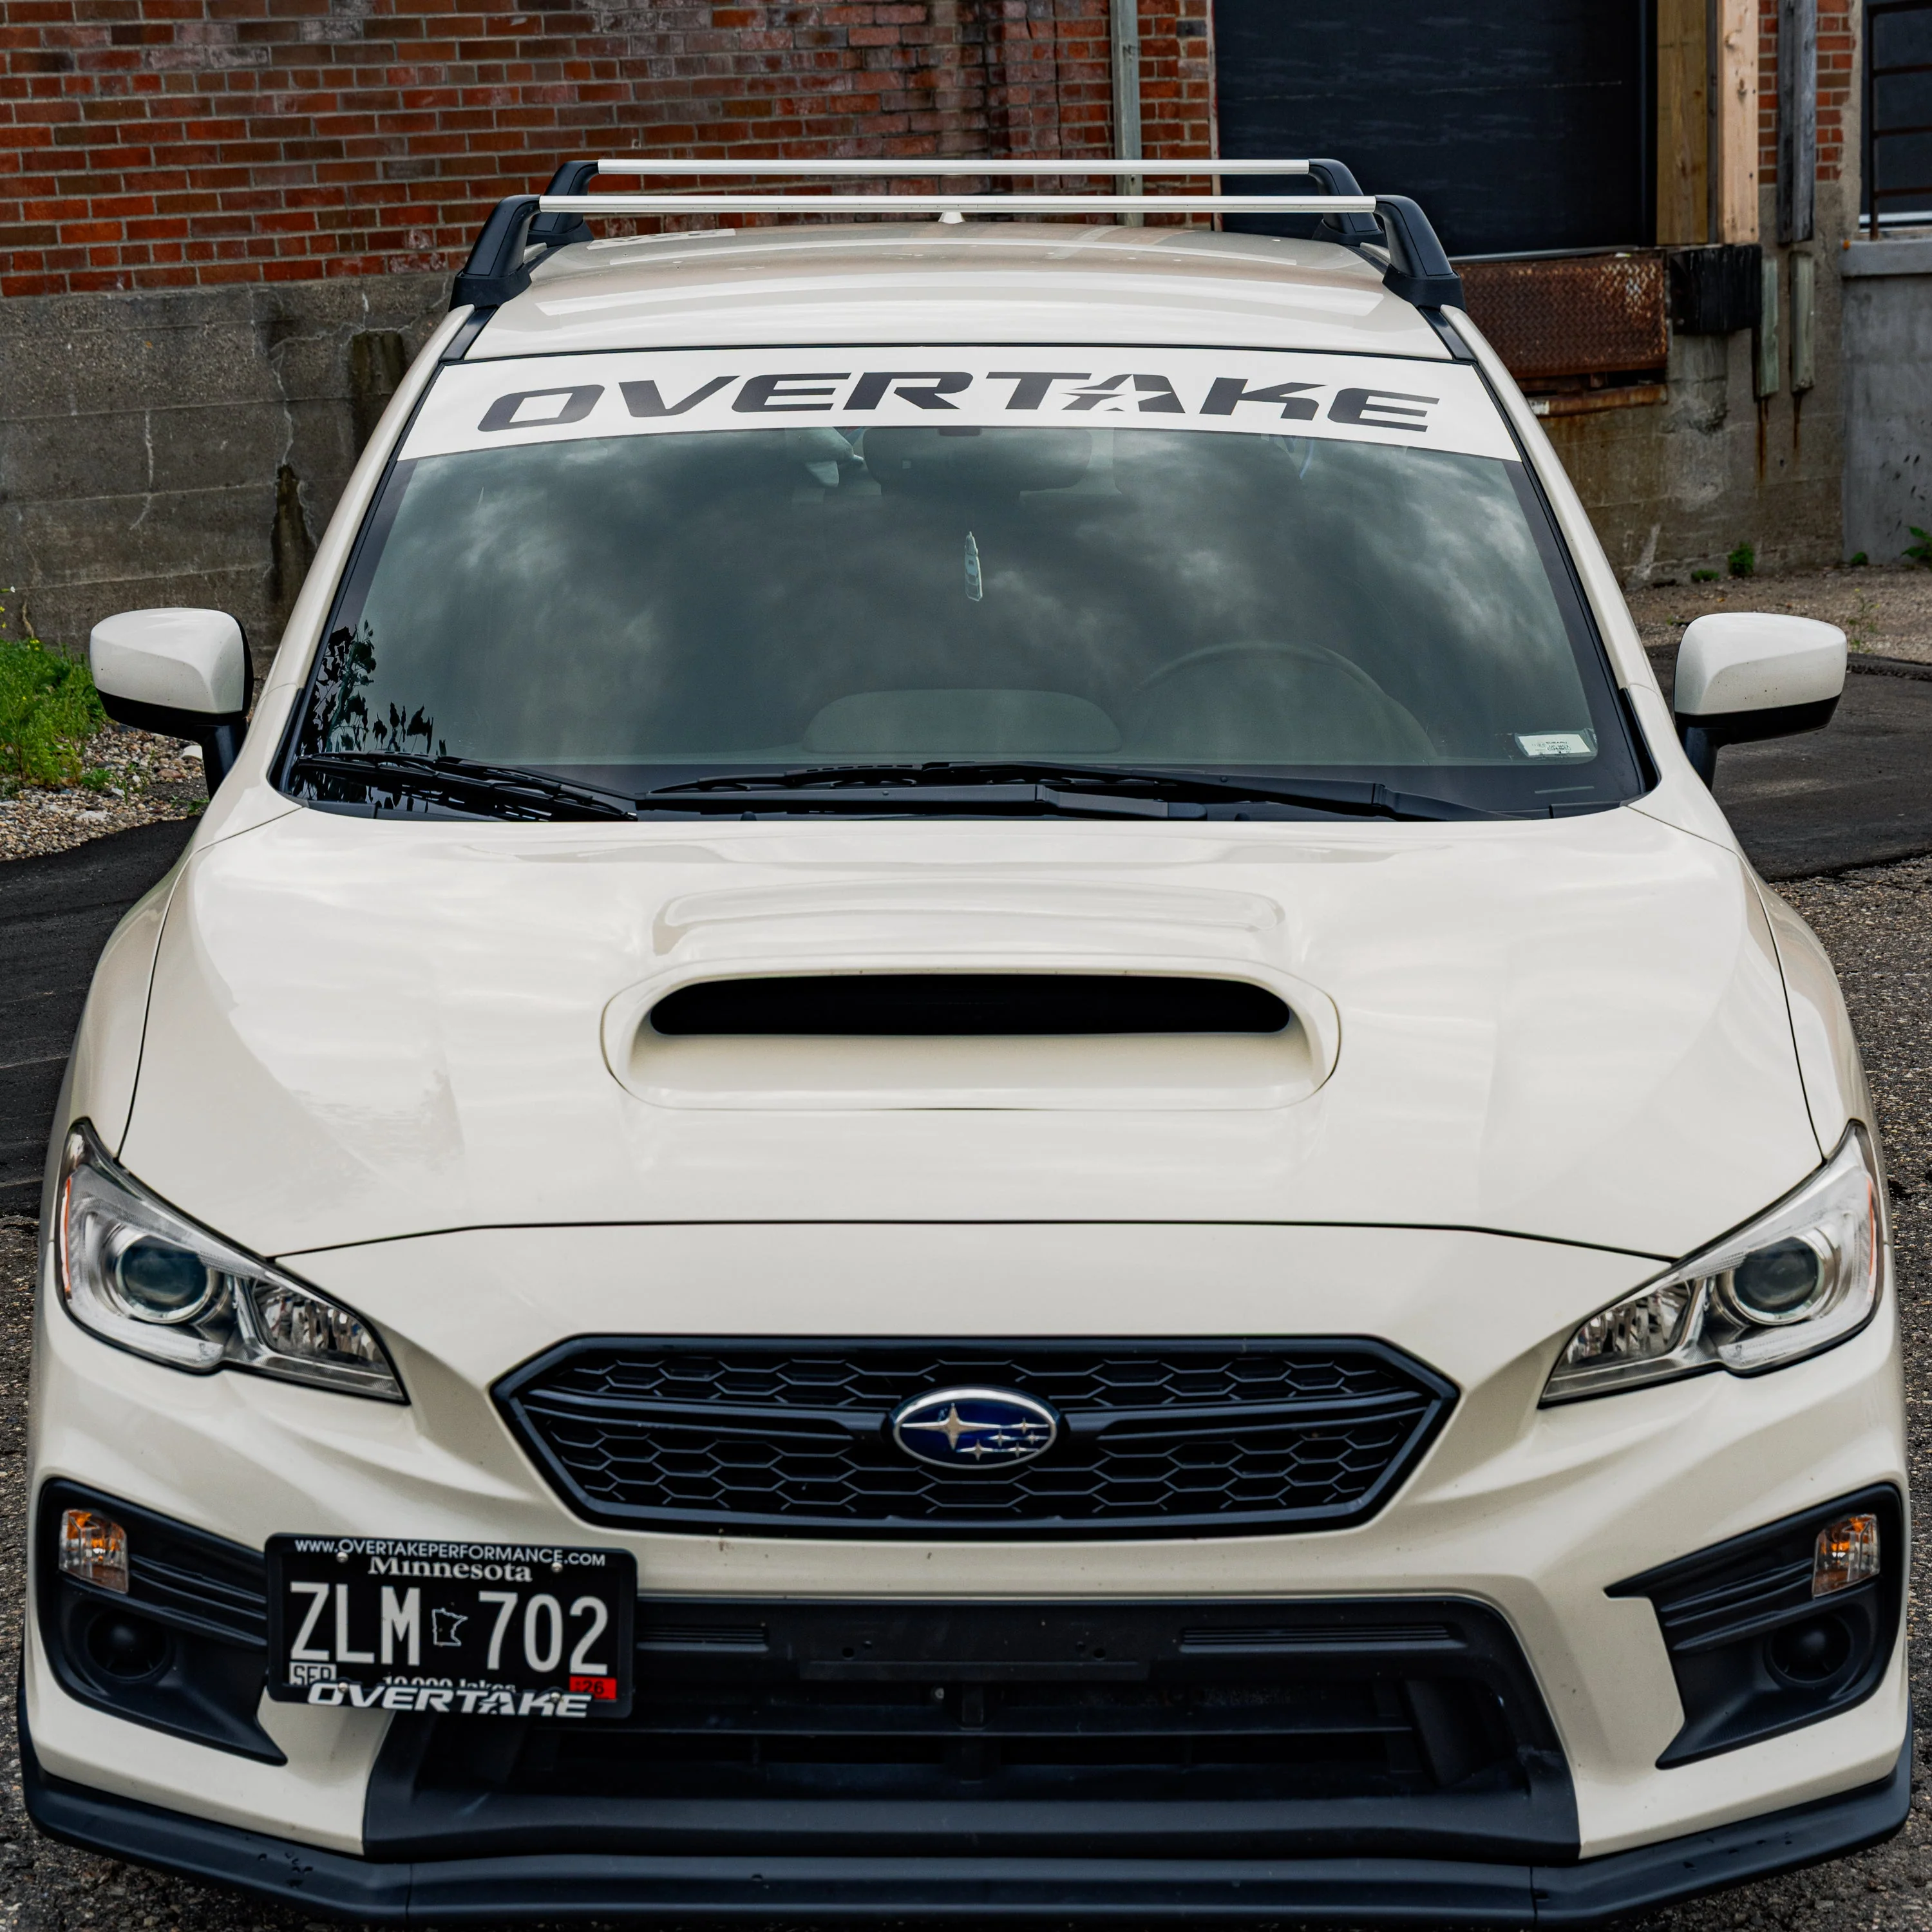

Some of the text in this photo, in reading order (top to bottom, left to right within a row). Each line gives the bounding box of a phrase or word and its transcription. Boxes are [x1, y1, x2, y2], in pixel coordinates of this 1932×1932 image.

[477, 371, 1440, 433] OVERTAKE
[367, 1556, 533, 1582] Minnesota
[290, 1580, 609, 1676] ZLM 702
[308, 1681, 592, 1718] OVERTAKE
[582, 1680, 604, 1695] 26
